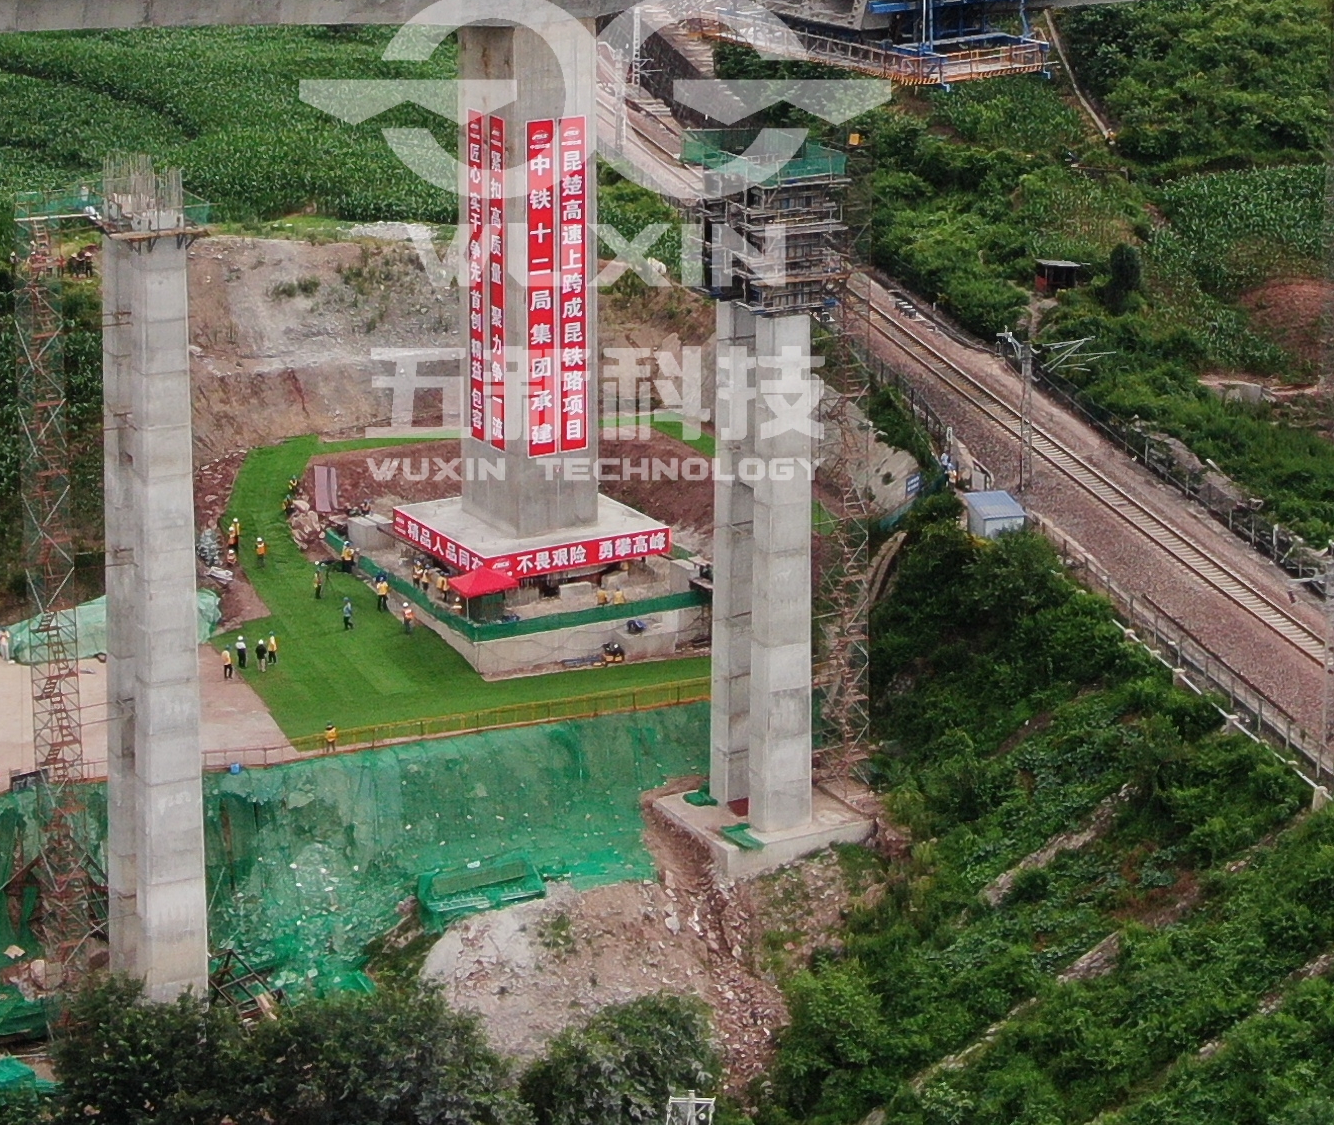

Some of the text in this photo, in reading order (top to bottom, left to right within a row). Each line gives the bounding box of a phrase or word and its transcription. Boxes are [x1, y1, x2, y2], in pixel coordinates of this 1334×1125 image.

[529, 155, 553, 445] 中铁十二局集团承建
[561, 150, 583, 440] 昆楚高速上跨成昆铁路项目
